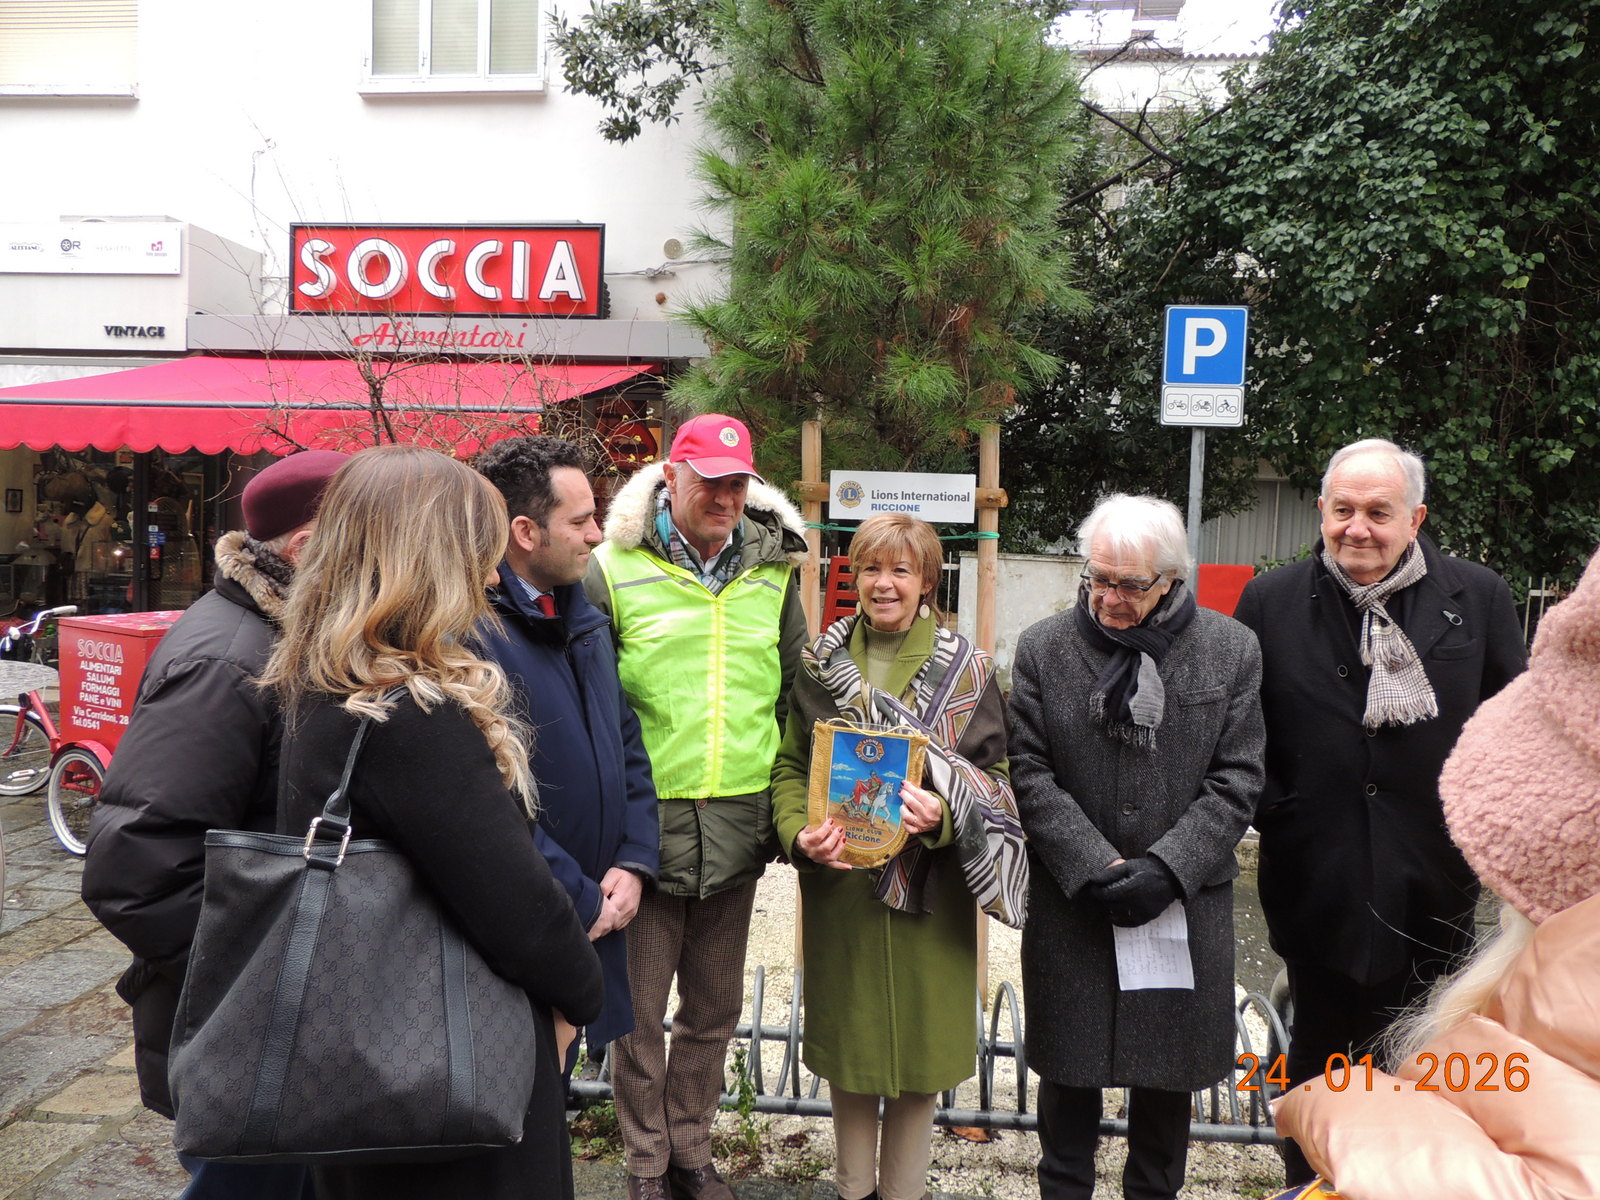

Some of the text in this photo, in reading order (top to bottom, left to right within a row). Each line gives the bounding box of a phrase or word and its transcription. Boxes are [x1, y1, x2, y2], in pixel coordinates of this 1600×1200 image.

[297, 237, 587, 303] SOCCIA
[103, 325, 166, 338] VINTAGE
[352, 321, 529, 348] Alimentari
[1182, 317, 1228, 375] P
[871, 489, 970, 502] Lions International
[871, 504, 921, 512] RICCIONE
[78, 639, 124, 663] SOCCIA
[80, 661, 122, 675] ALIMENTARI
[86, 672, 115, 685] SALUMI
[81, 681, 120, 697] FORMAGGI
[79, 691, 100, 704] PANE
[105, 696, 122, 708] VINI
[73, 705, 85, 716] Via
[865, 745, 874, 757] L
[845, 831, 881, 844] Riccione
